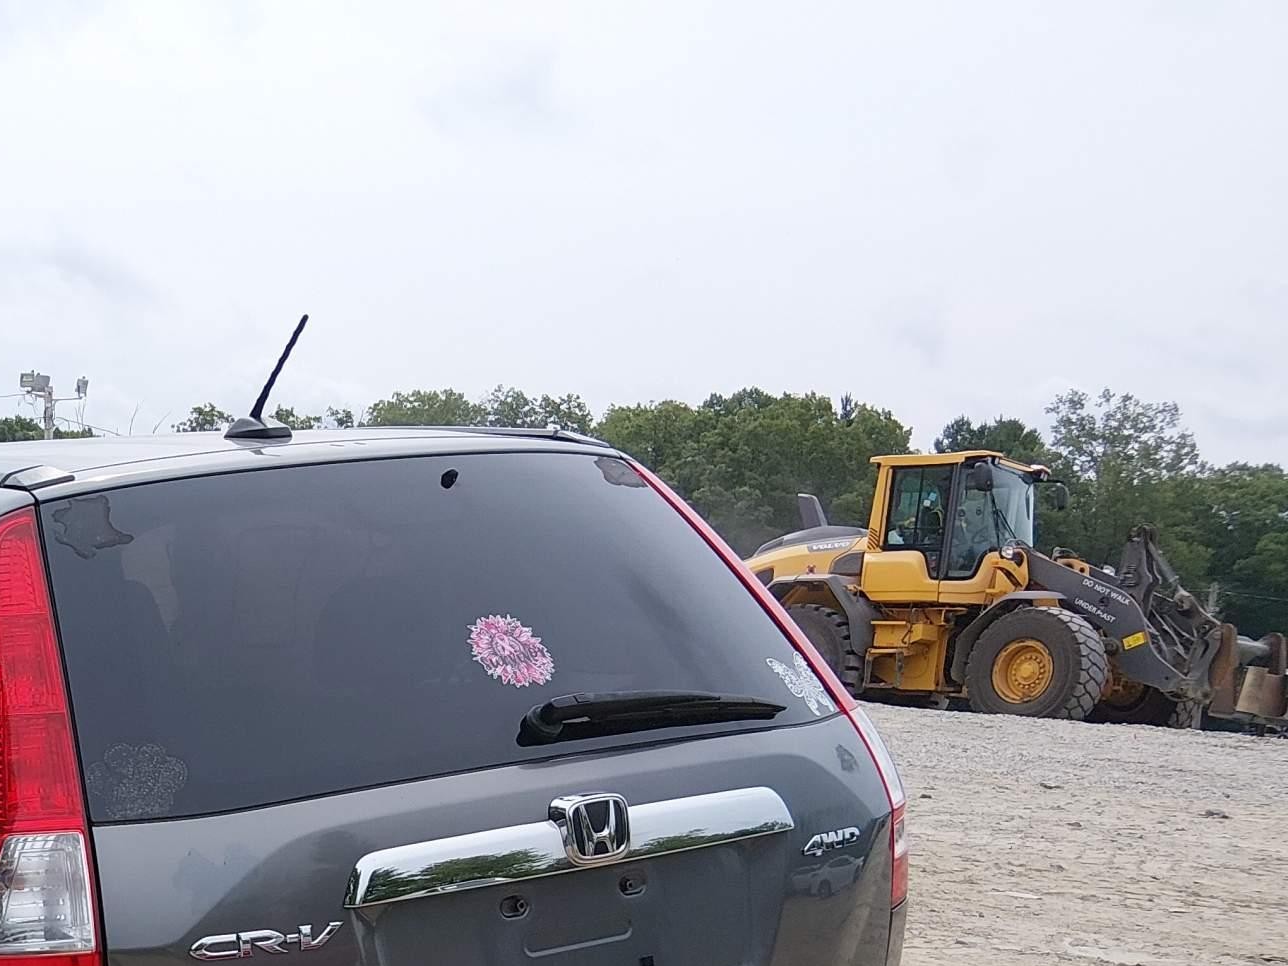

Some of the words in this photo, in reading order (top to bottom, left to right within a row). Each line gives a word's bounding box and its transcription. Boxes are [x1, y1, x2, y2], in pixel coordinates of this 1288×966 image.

[812, 541, 850, 550] VOLVO
[1082, 578, 1094, 587] DO
[1094, 584, 1110, 595] NOT
[1110, 591, 1130, 605] WALK
[1074, 597, 1098, 614] UNDER
[1096, 609, 1116, 623] MAST
[803, 826, 861, 857] 4WD
[189, 921, 345, 961] CR-V
